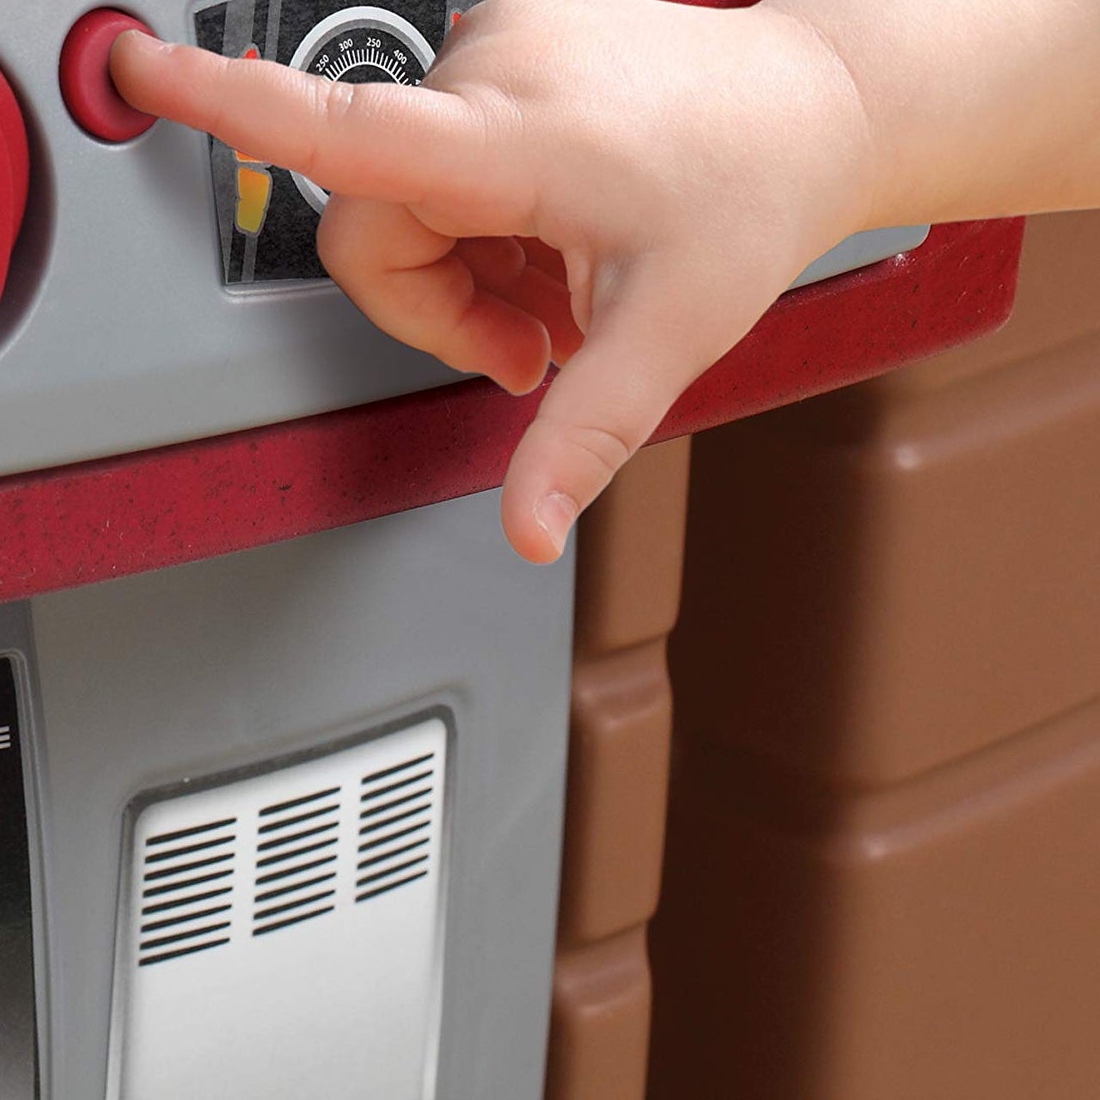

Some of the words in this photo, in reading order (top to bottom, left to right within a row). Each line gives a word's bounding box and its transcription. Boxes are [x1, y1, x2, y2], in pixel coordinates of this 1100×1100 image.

[315, 54, 330, 73] 250
[338, 38, 354, 52] 300
[366, 36, 382, 49] 250
[393, 49, 408, 65] 400
